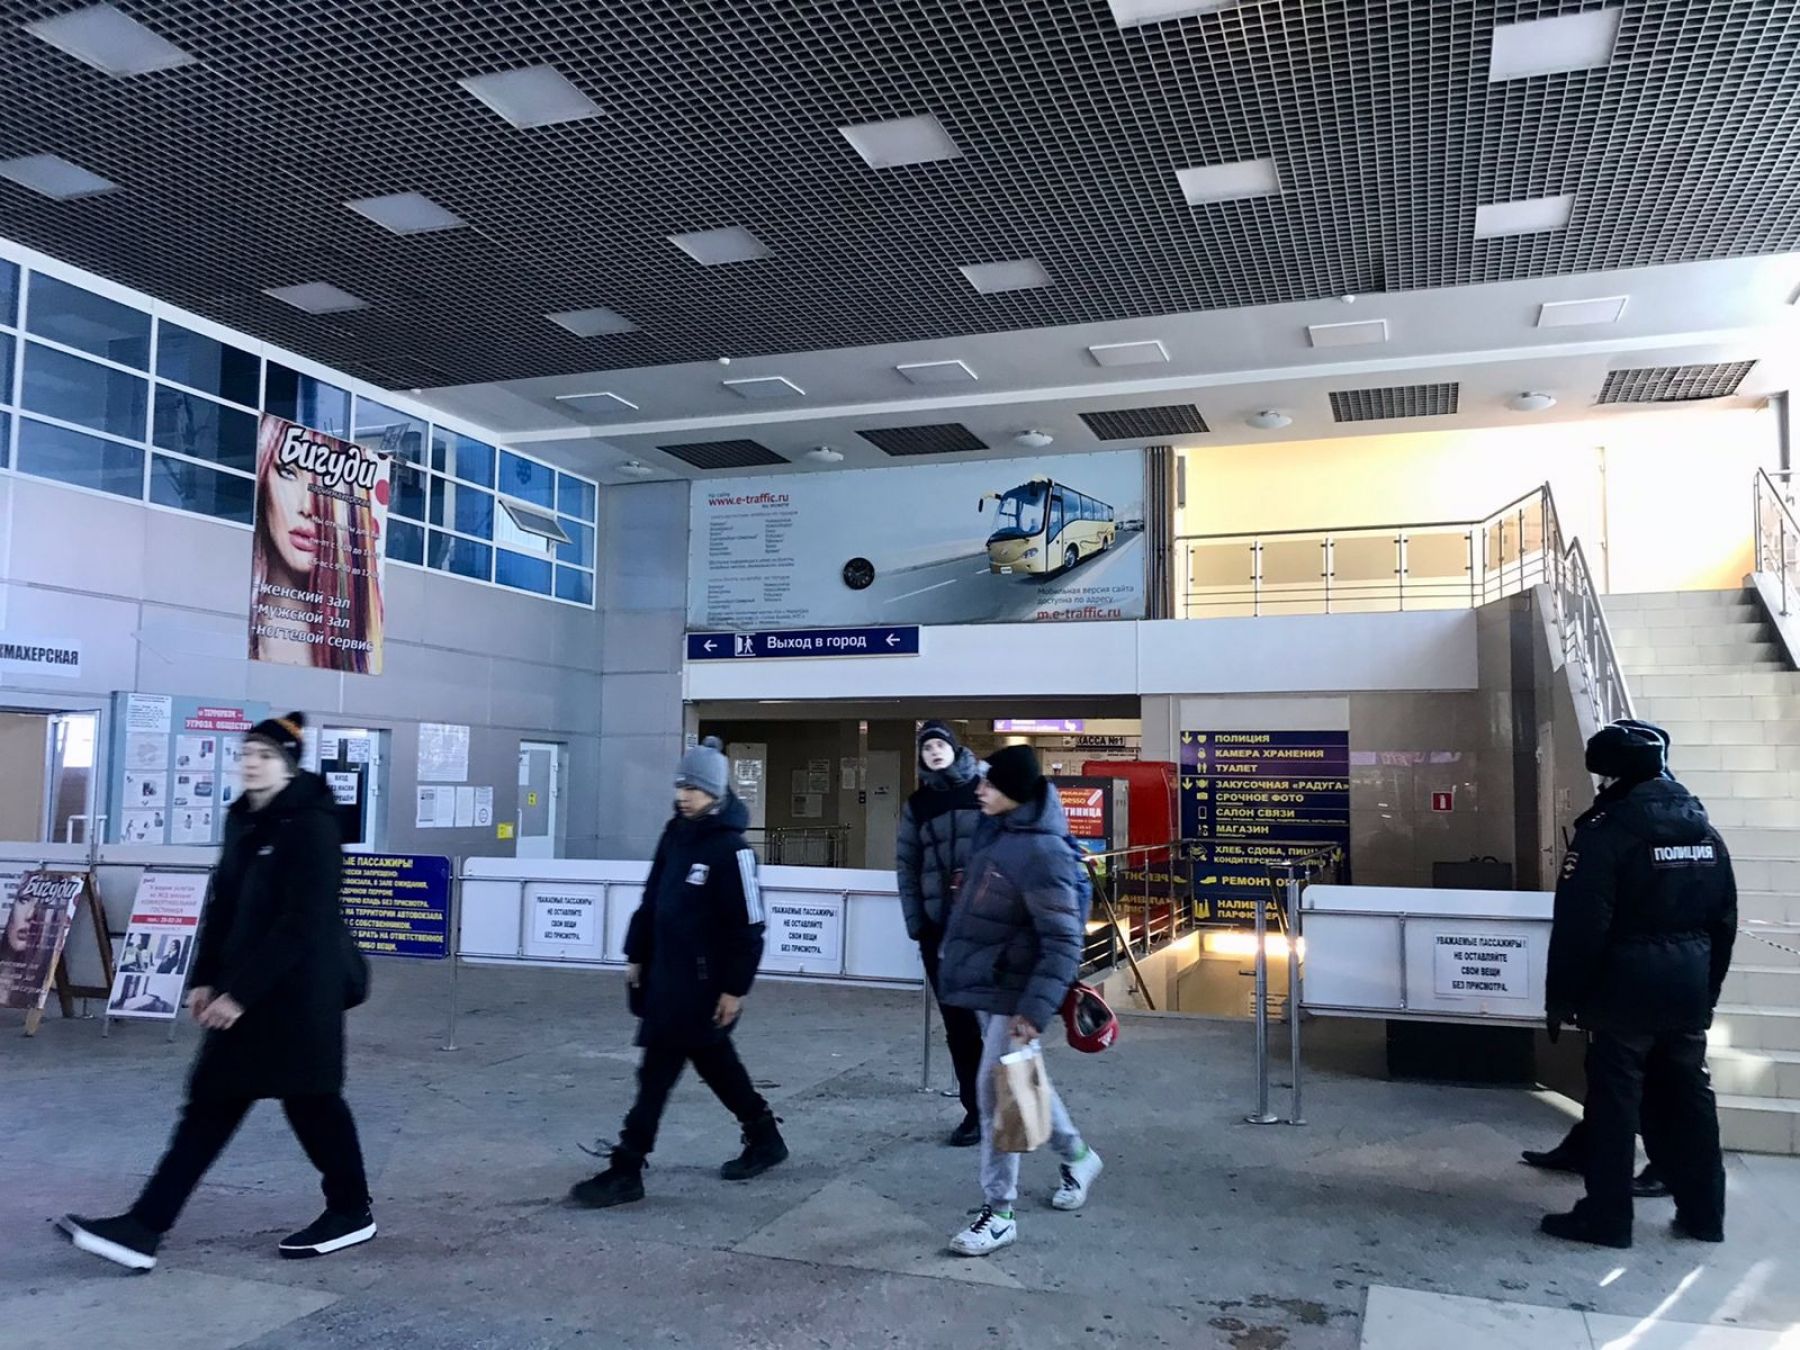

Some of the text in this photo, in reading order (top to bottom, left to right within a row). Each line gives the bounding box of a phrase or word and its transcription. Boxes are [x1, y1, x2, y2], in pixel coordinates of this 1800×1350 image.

[281, 426, 377, 489] Бигуди
[708, 493, 789, 506] www.e-traffic.ru
[1111, 585, 1134, 593] сайта
[326, 595, 350, 609] зал
[1037, 606, 1121, 620] m.e-traffic.ru
[326, 615, 350, 629] зал
[767, 636, 867, 649] Выход в город
[1215, 734, 1270, 743] ПОЛИЦИЯ
[1215, 750, 1324, 758] КАМЕРА ХРАНЕНИЯ
[1215, 764, 1258, 773] ТУАЛЕТ
[1216, 781, 1349, 791] ЗАКУСОЧНАЯ «РАДУГА»
[1216, 793, 1304, 803] СРОЧНОЕ ФОТО
[1216, 808, 1295, 818] САЛОН СВЯЗИ
[1216, 825, 1269, 834] МАГАЗИН
[1215, 846, 1245, 855] ХЛЕБ,
[1247, 847, 1286, 856] СДОБА,
[1654, 845, 1713, 861] ПОЛИЦИЯ
[23, 875, 79, 903] Бигуди
[1436, 936, 1477, 946] УВАЖАЕМЫЕ
[1454, 952, 1507, 963] НЕ ОСТАВЛЯЙТЕ
[1461, 966, 1501, 977] СВОИ ВЕЩИ
[1452, 980, 1465, 989] БЕЗ
